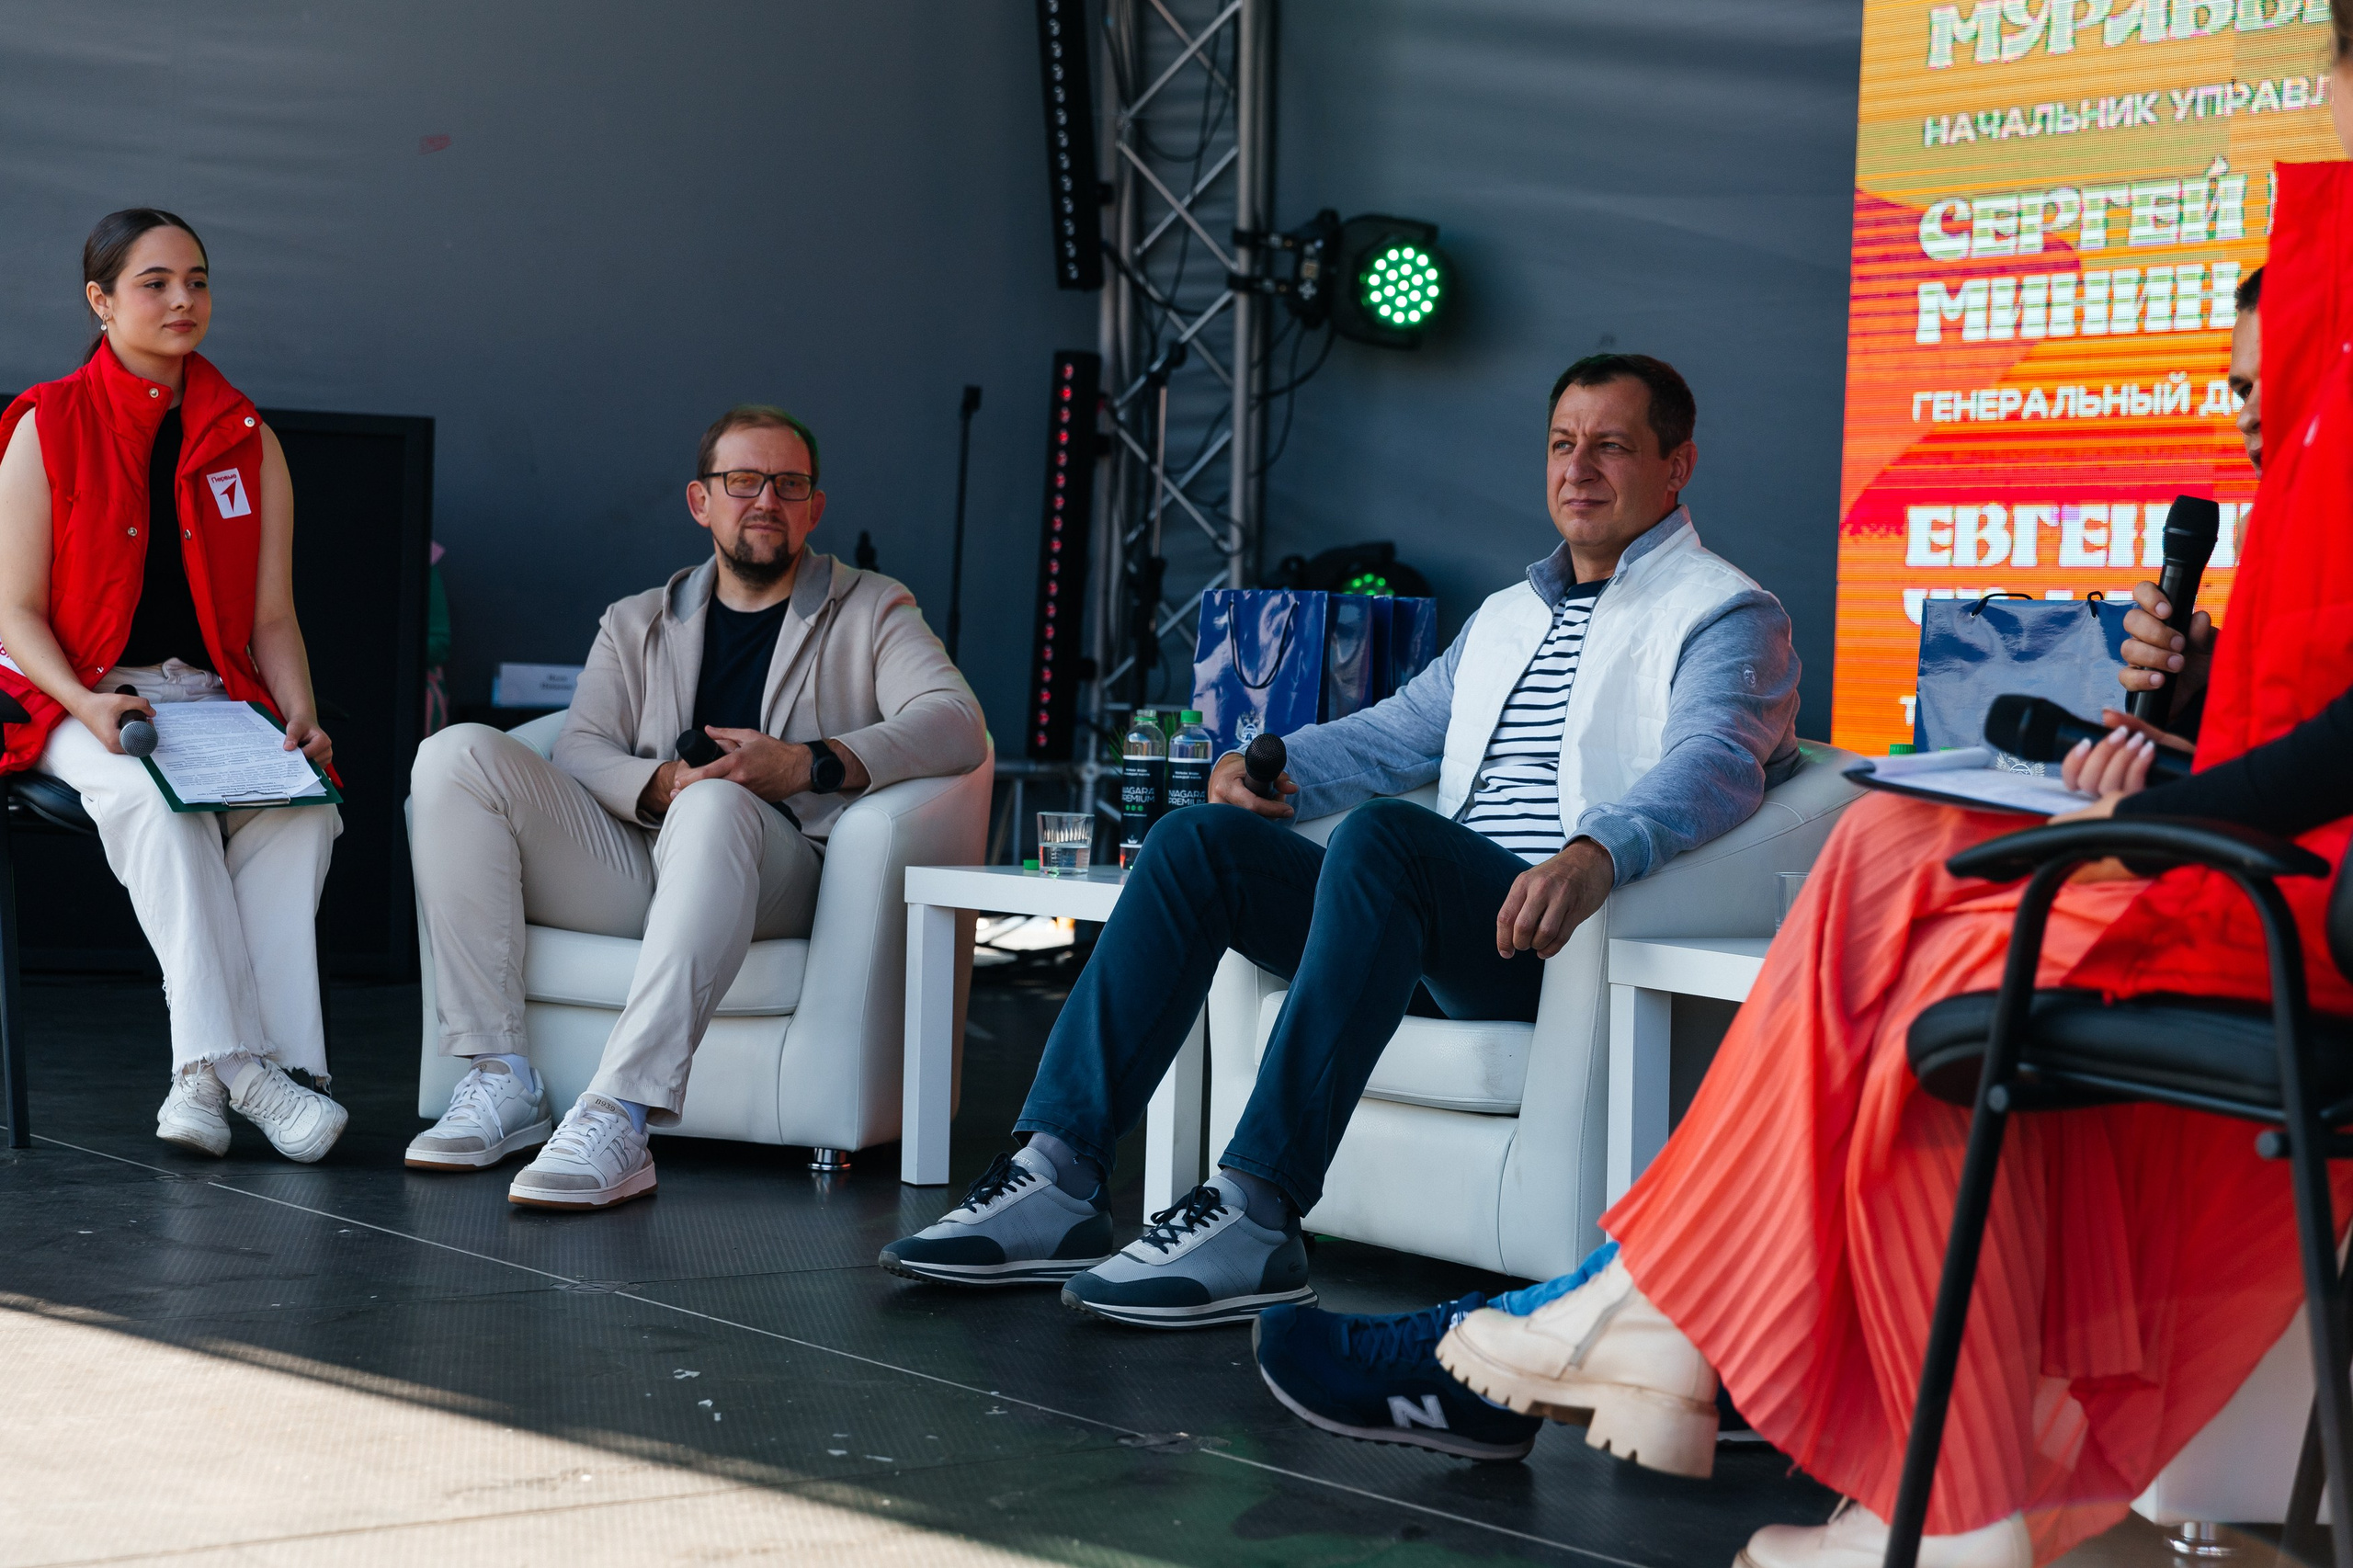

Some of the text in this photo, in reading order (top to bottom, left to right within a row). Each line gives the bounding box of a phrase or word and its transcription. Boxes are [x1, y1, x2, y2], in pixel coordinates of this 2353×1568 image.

[1923, 92, 2159, 147] НАЧАЛЬНИК
[1918, 154, 2248, 261] СЕРГЕЙ
[1912, 371, 2190, 423] ГЕНЕРАЛЬНЫЙ
[211, 473, 237, 483] Первые
[1904, 502, 2252, 568] ЕВГЕН
